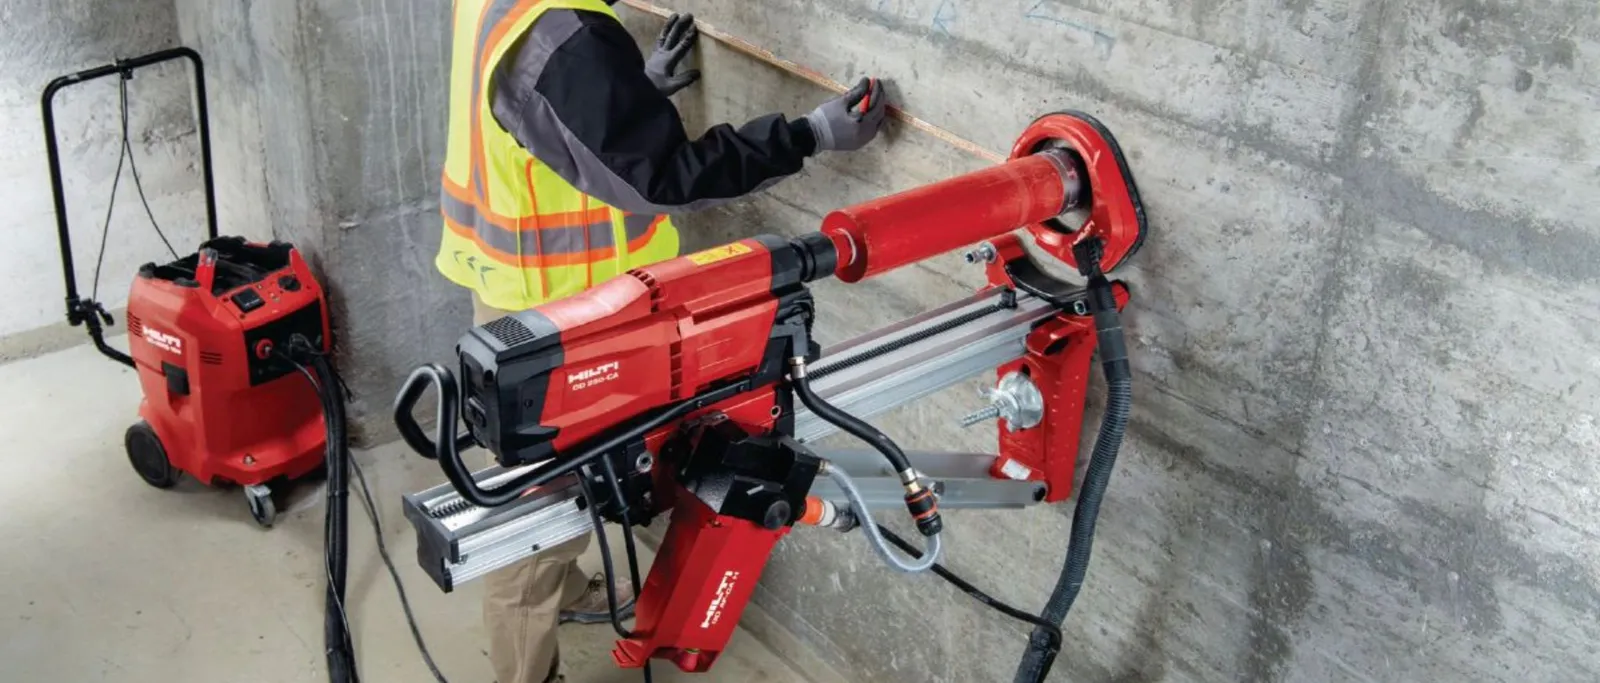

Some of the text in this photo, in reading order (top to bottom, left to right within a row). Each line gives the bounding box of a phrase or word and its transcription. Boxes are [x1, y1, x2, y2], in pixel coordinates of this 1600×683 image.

[142, 325, 182, 348] HILTI
[568, 361, 619, 384] HILTI
[700, 570, 733, 628] HILTI
